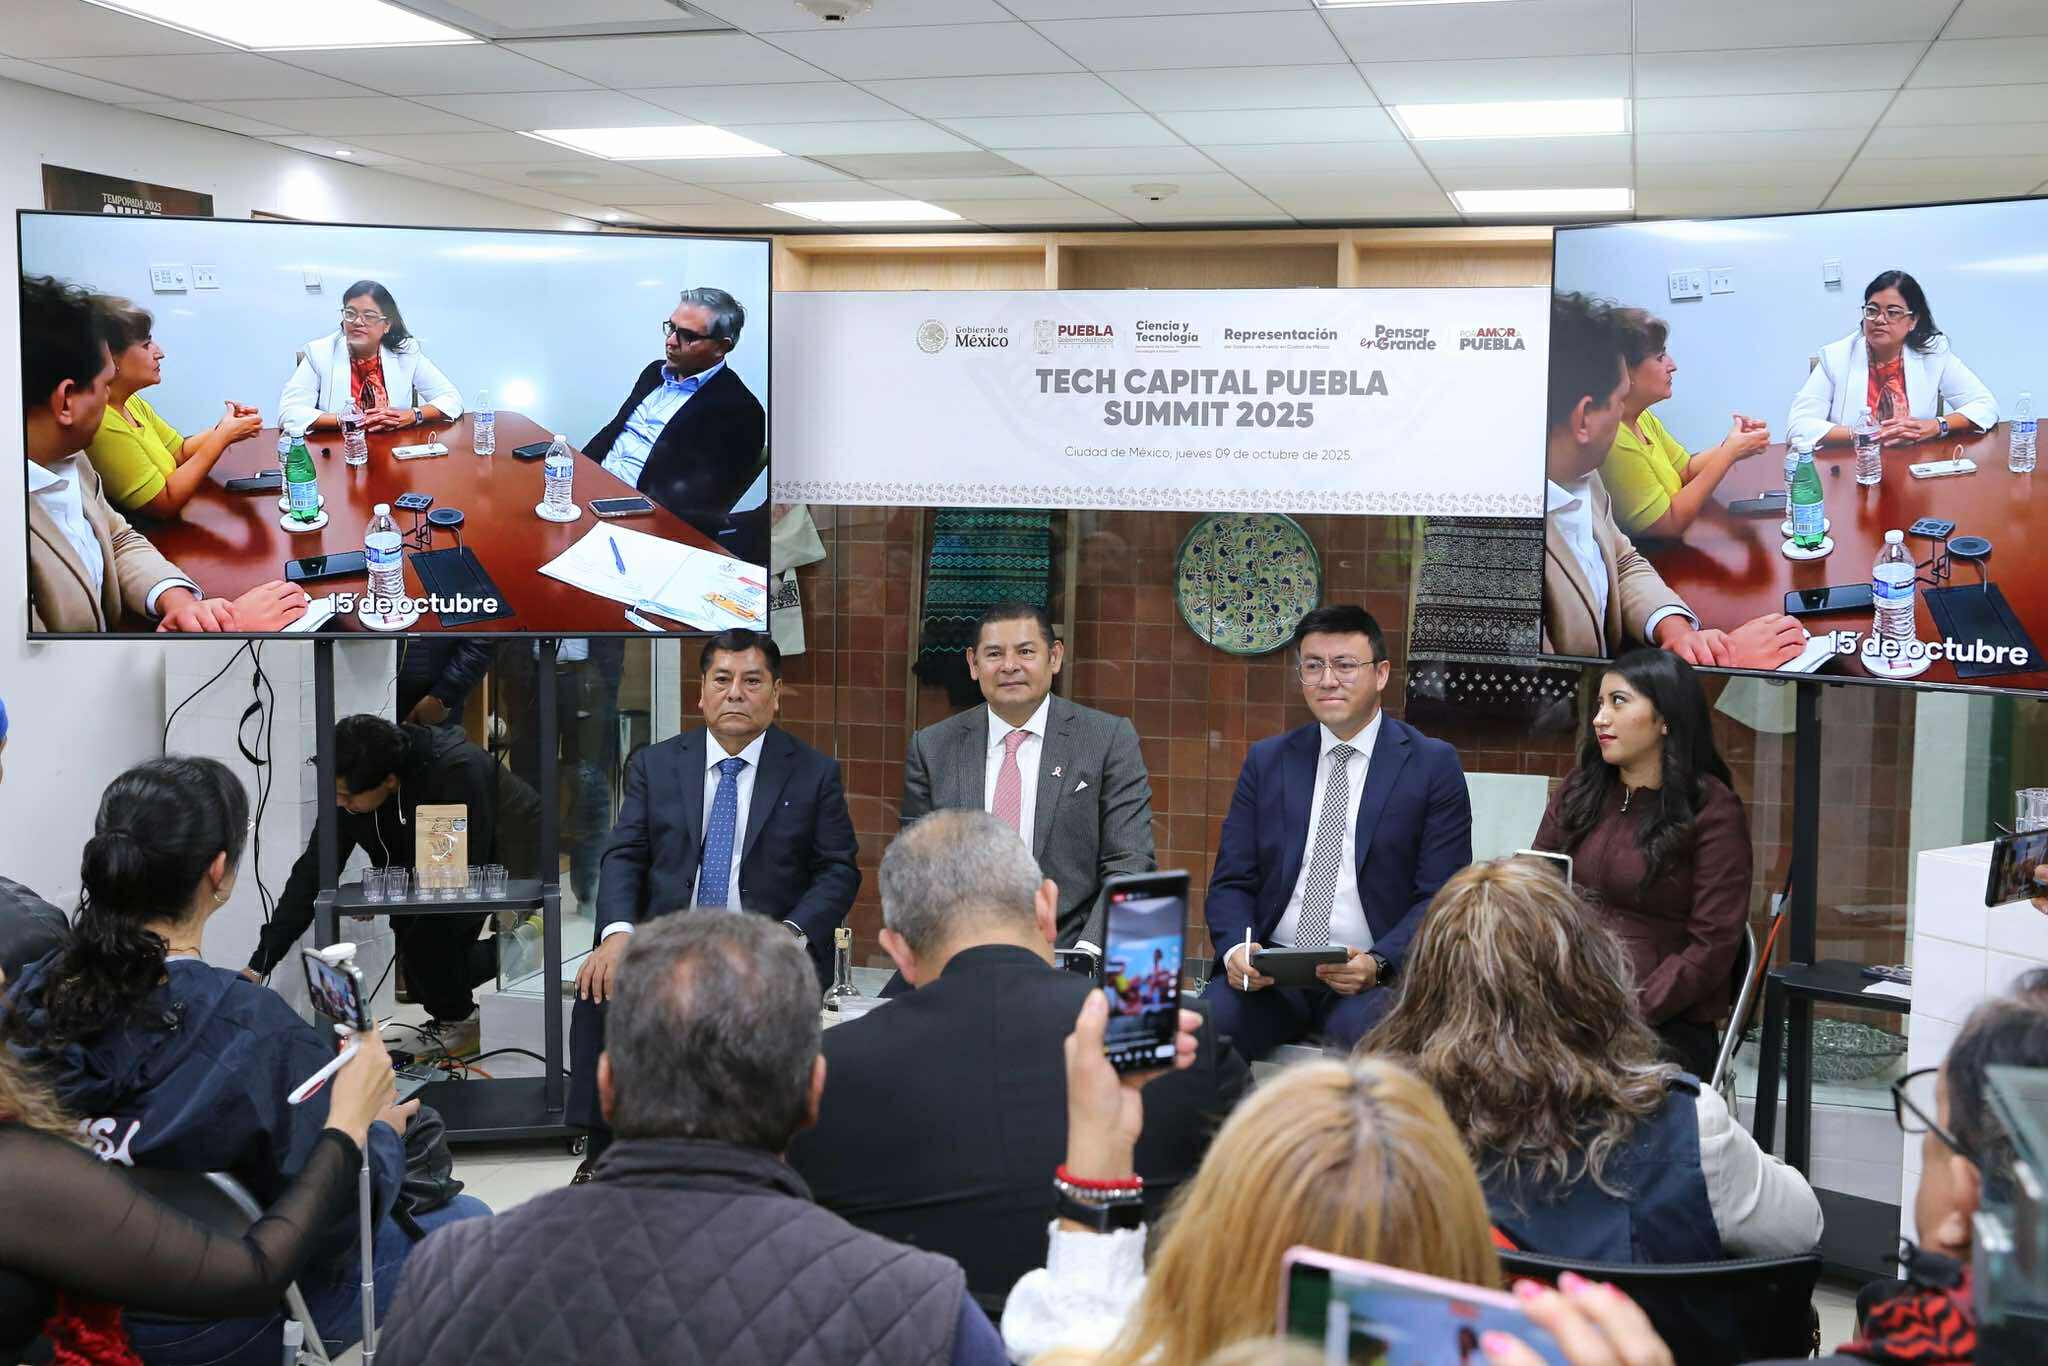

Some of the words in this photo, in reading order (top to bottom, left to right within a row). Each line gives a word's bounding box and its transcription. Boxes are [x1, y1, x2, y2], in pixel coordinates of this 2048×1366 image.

[102, 193, 144, 209] TEMPORADA
[145, 200, 162, 212] 2025
[955, 326, 995, 334] Gobierno
[997, 326, 1009, 334] de
[1058, 325, 1114, 336] PUEBLA
[1136, 320, 1180, 331] Ciencia
[1181, 322, 1190, 332] y
[1375, 325, 1430, 338] Pensar
[1476, 327, 1516, 337] AMOR
[955, 333, 1009, 348] México
[1136, 331, 1199, 345] Tecnología
[1224, 327, 1338, 343] Representación
[1360, 336, 1378, 348] en
[1377, 337, 1437, 350] Grande
[1459, 338, 1526, 350] PUEBLA
[1035, 368, 1116, 394] TECH
[1124, 368, 1258, 395] CAPITAL
[1266, 369, 1389, 396] PUEBLA
[1103, 400, 1229, 426] SUMMIT
[1236, 401, 1314, 428] 2025
[1065, 446, 1109, 458] Ciudad
[1110, 446, 1126, 458] de
[1129, 446, 1173, 460] México,
[1175, 448, 1212, 461] jueves
[1215, 448, 1231, 460] 09
[1233, 448, 1249, 460] de
[1252, 448, 1299, 460] octubre
[1302, 448, 1318, 461] de
[1322, 449, 1353, 461] 2025.
[358, 592, 392, 614] de
[397, 592, 499, 614] octubre
[1862, 632, 1900, 658] de
[1905, 637, 2029, 665] octubre
